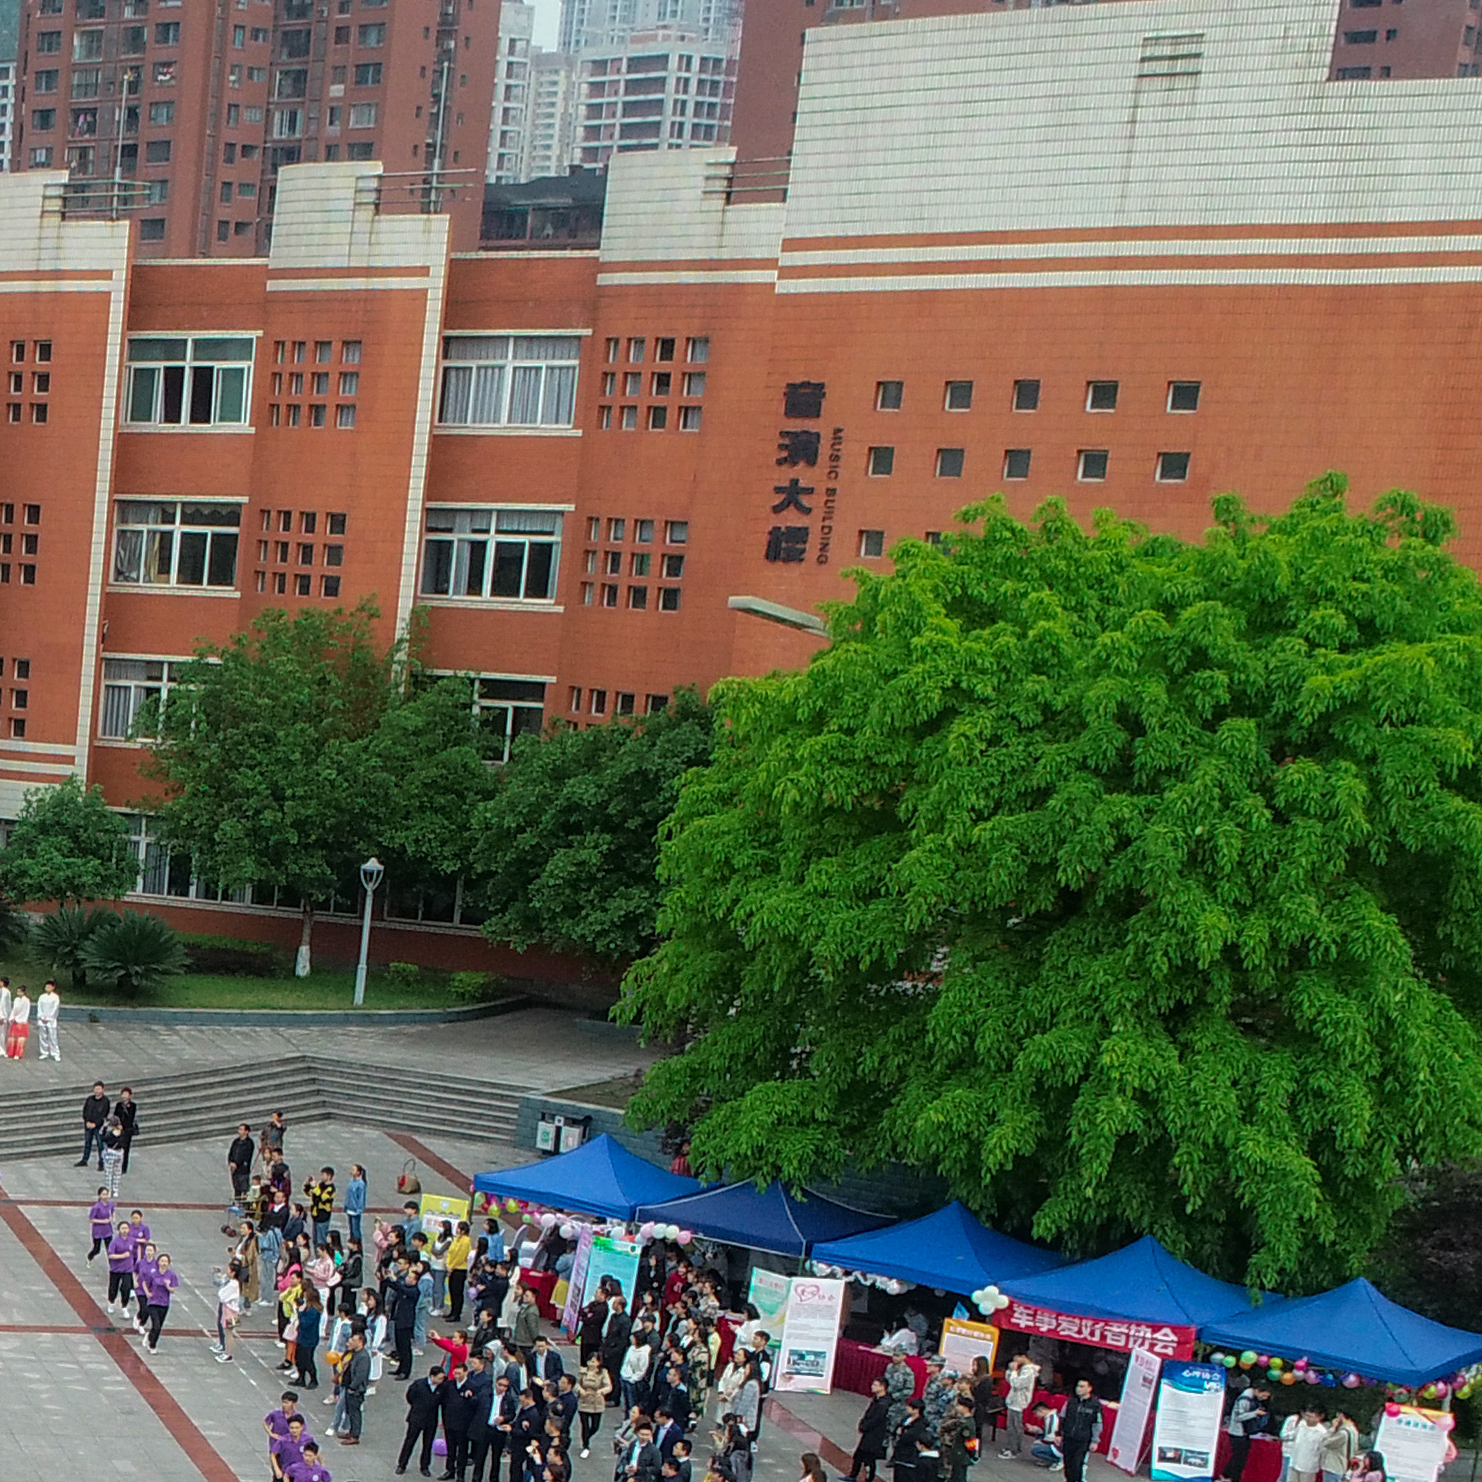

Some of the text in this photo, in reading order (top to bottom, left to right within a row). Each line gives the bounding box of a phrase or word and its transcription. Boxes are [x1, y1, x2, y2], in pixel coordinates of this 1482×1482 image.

[817, 427, 844, 565] MUSIC BUILDING
[1010, 1303, 1179, 1356] 军事爱好者协会
